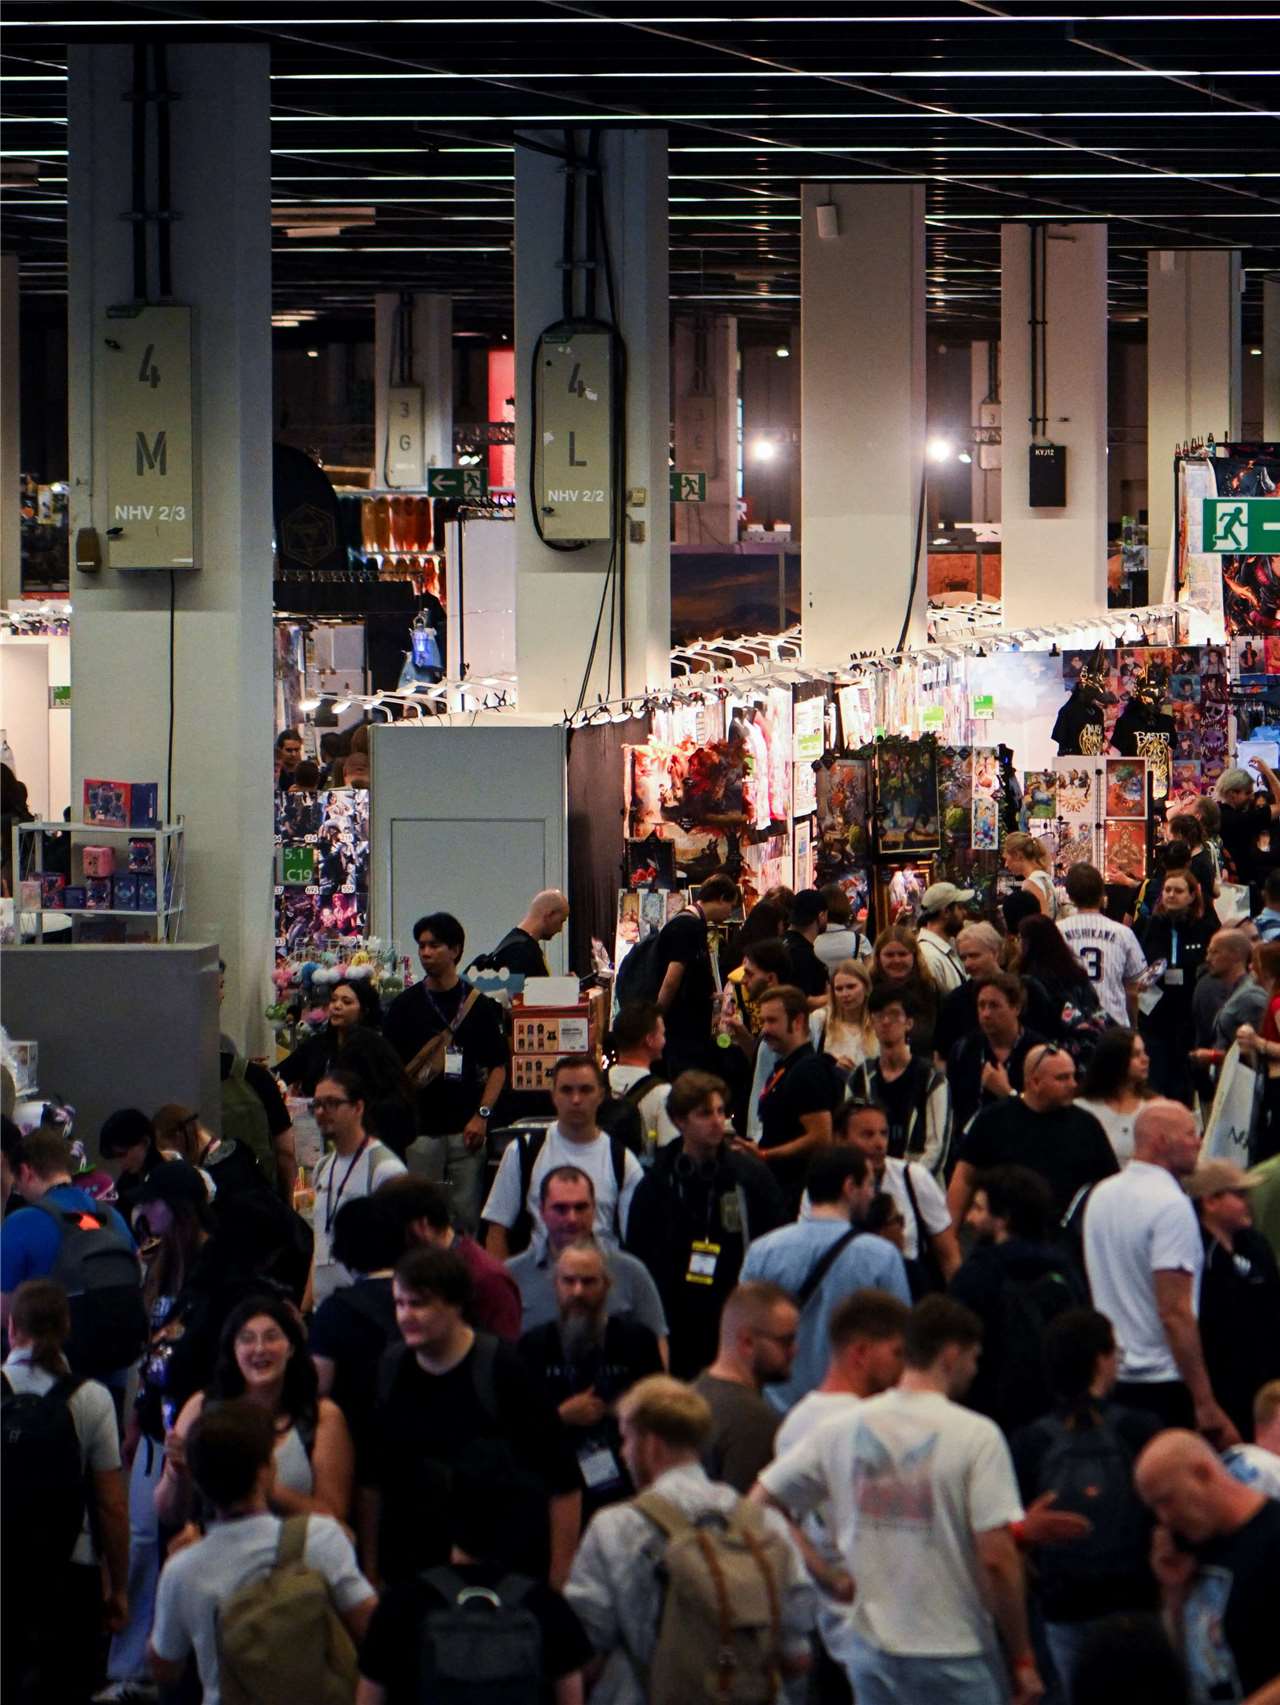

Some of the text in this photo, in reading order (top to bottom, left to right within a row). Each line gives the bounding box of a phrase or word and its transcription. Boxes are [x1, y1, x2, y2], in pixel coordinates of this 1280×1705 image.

[138, 343, 162, 389] 4
[136, 430, 167, 476] M
[568, 431, 588, 467] L
[547, 489, 605, 502] NHV 2/2
[114, 504, 187, 521] NHV 2/3
[284, 848, 304, 860] 5.1
[286, 869, 313, 882] C19
[1064, 927, 1117, 943] NISHIKAWA
